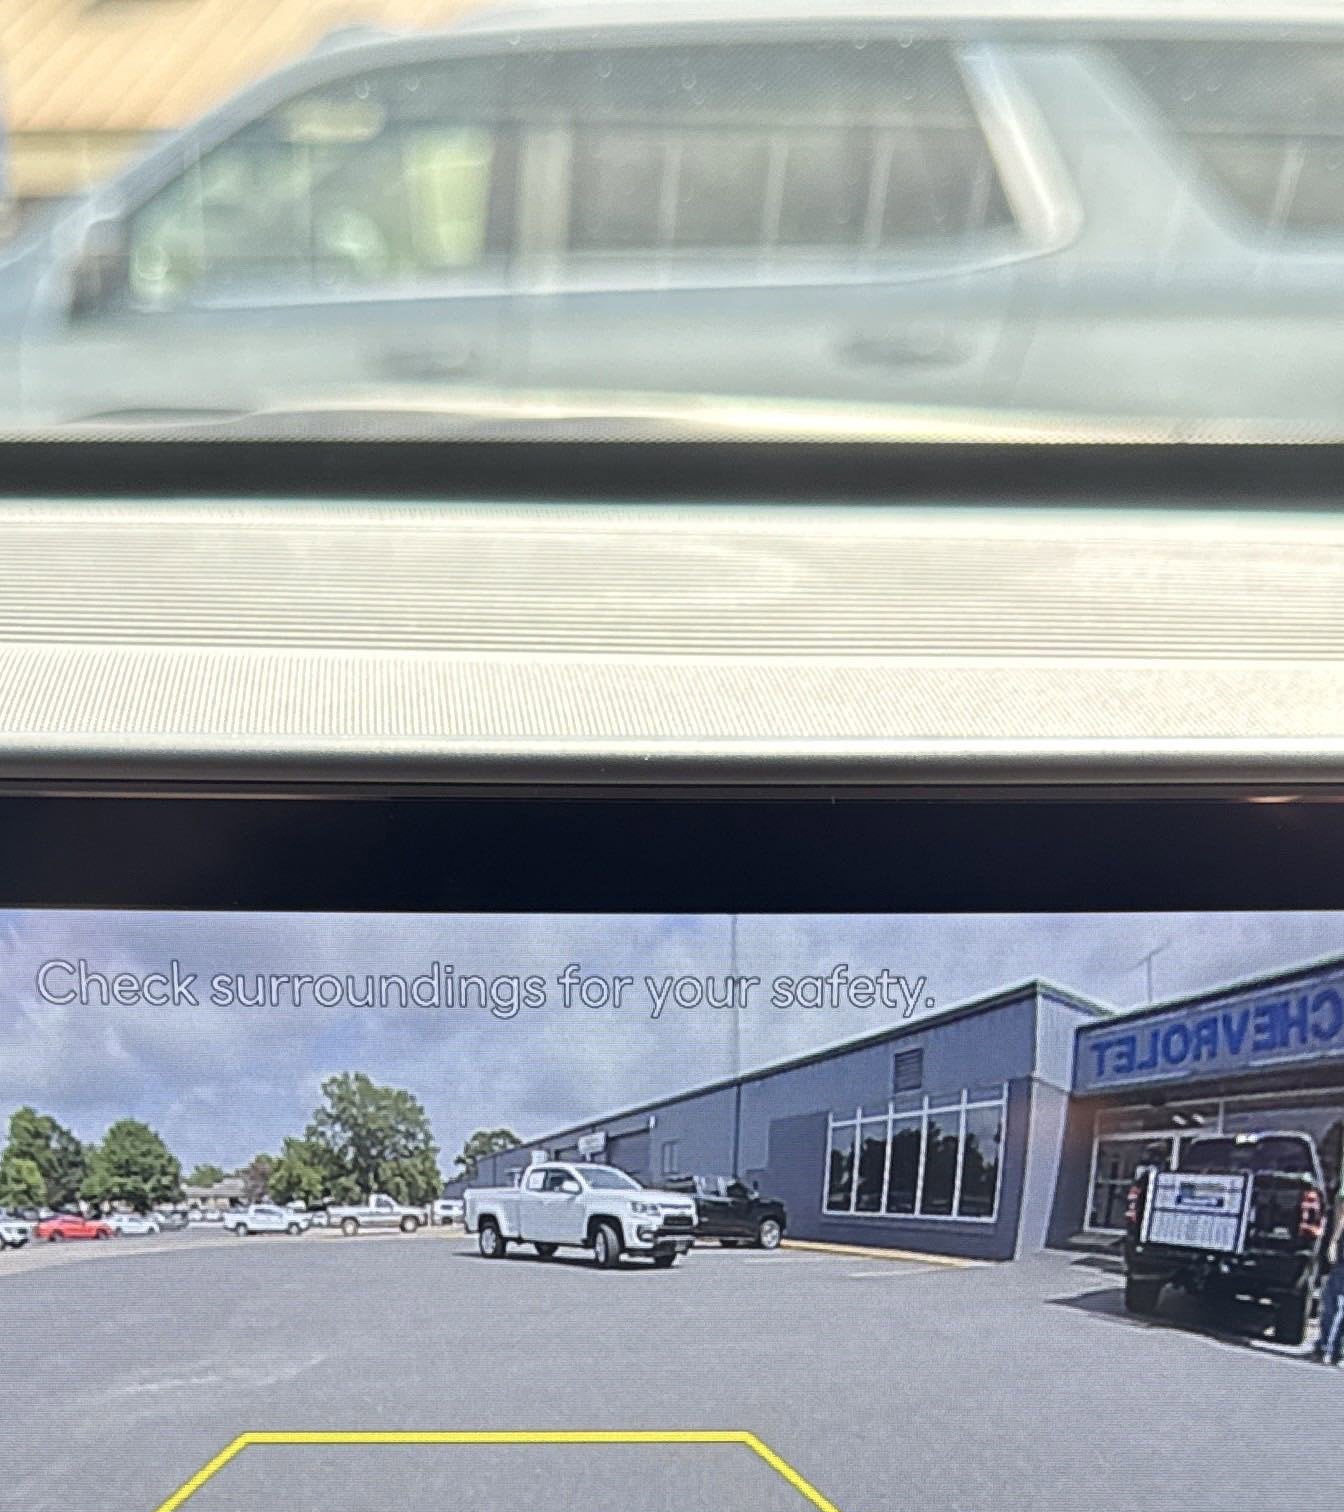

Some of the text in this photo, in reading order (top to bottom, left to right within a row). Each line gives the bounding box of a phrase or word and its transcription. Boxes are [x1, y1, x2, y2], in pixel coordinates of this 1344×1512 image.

[36, 959, 936, 1019] Check surroundings for your safety.
